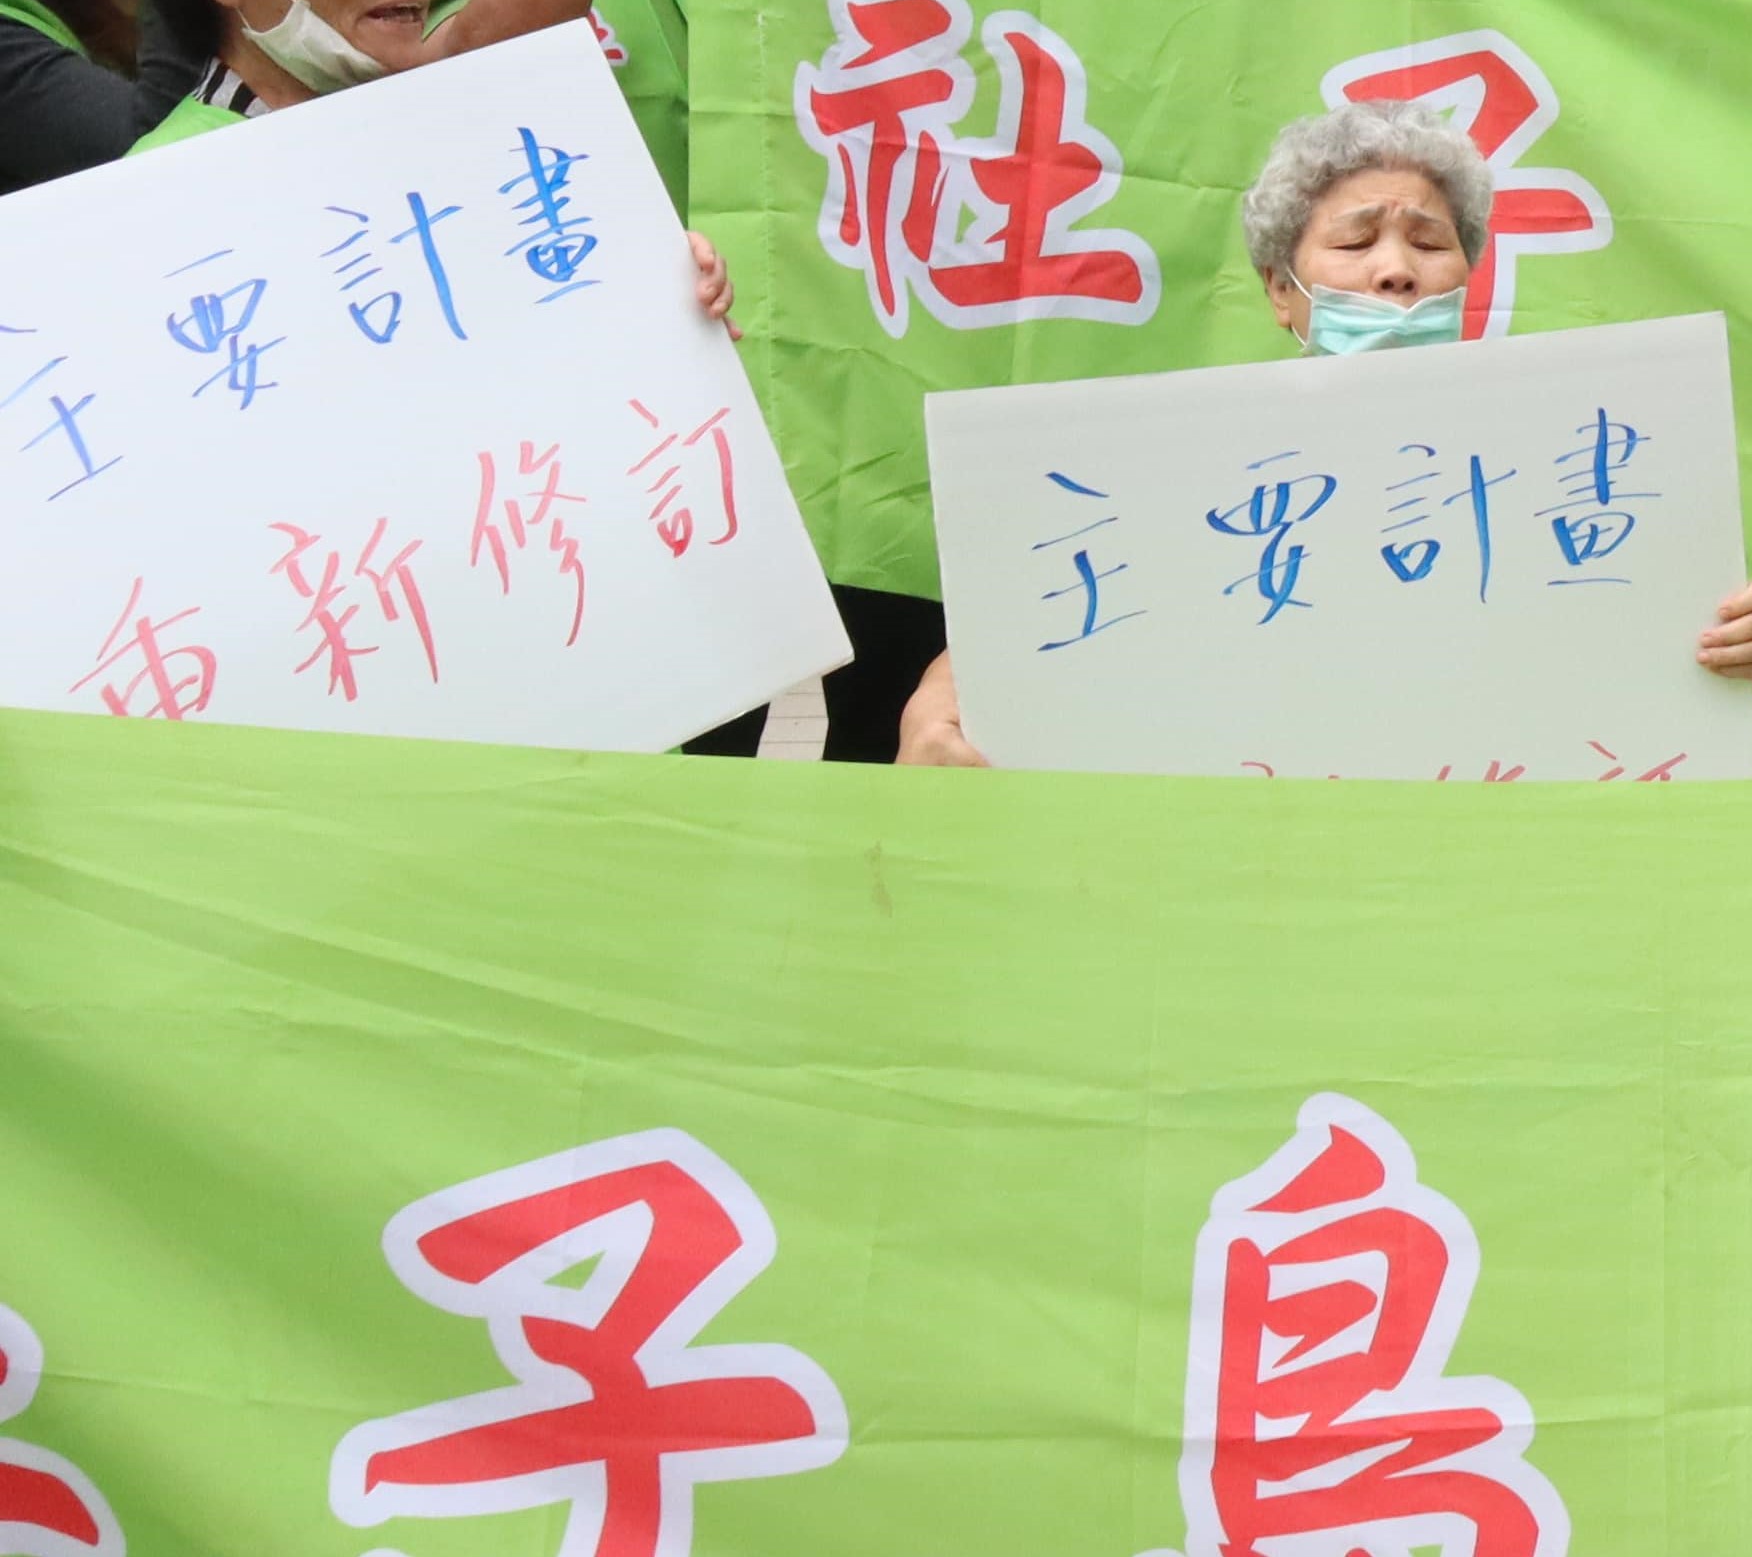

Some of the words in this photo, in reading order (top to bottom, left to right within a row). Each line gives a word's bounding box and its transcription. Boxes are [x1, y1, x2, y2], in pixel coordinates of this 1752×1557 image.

[0, 127, 602, 502] 主要計畫
[1031, 406, 1664, 653] 主要計畫
